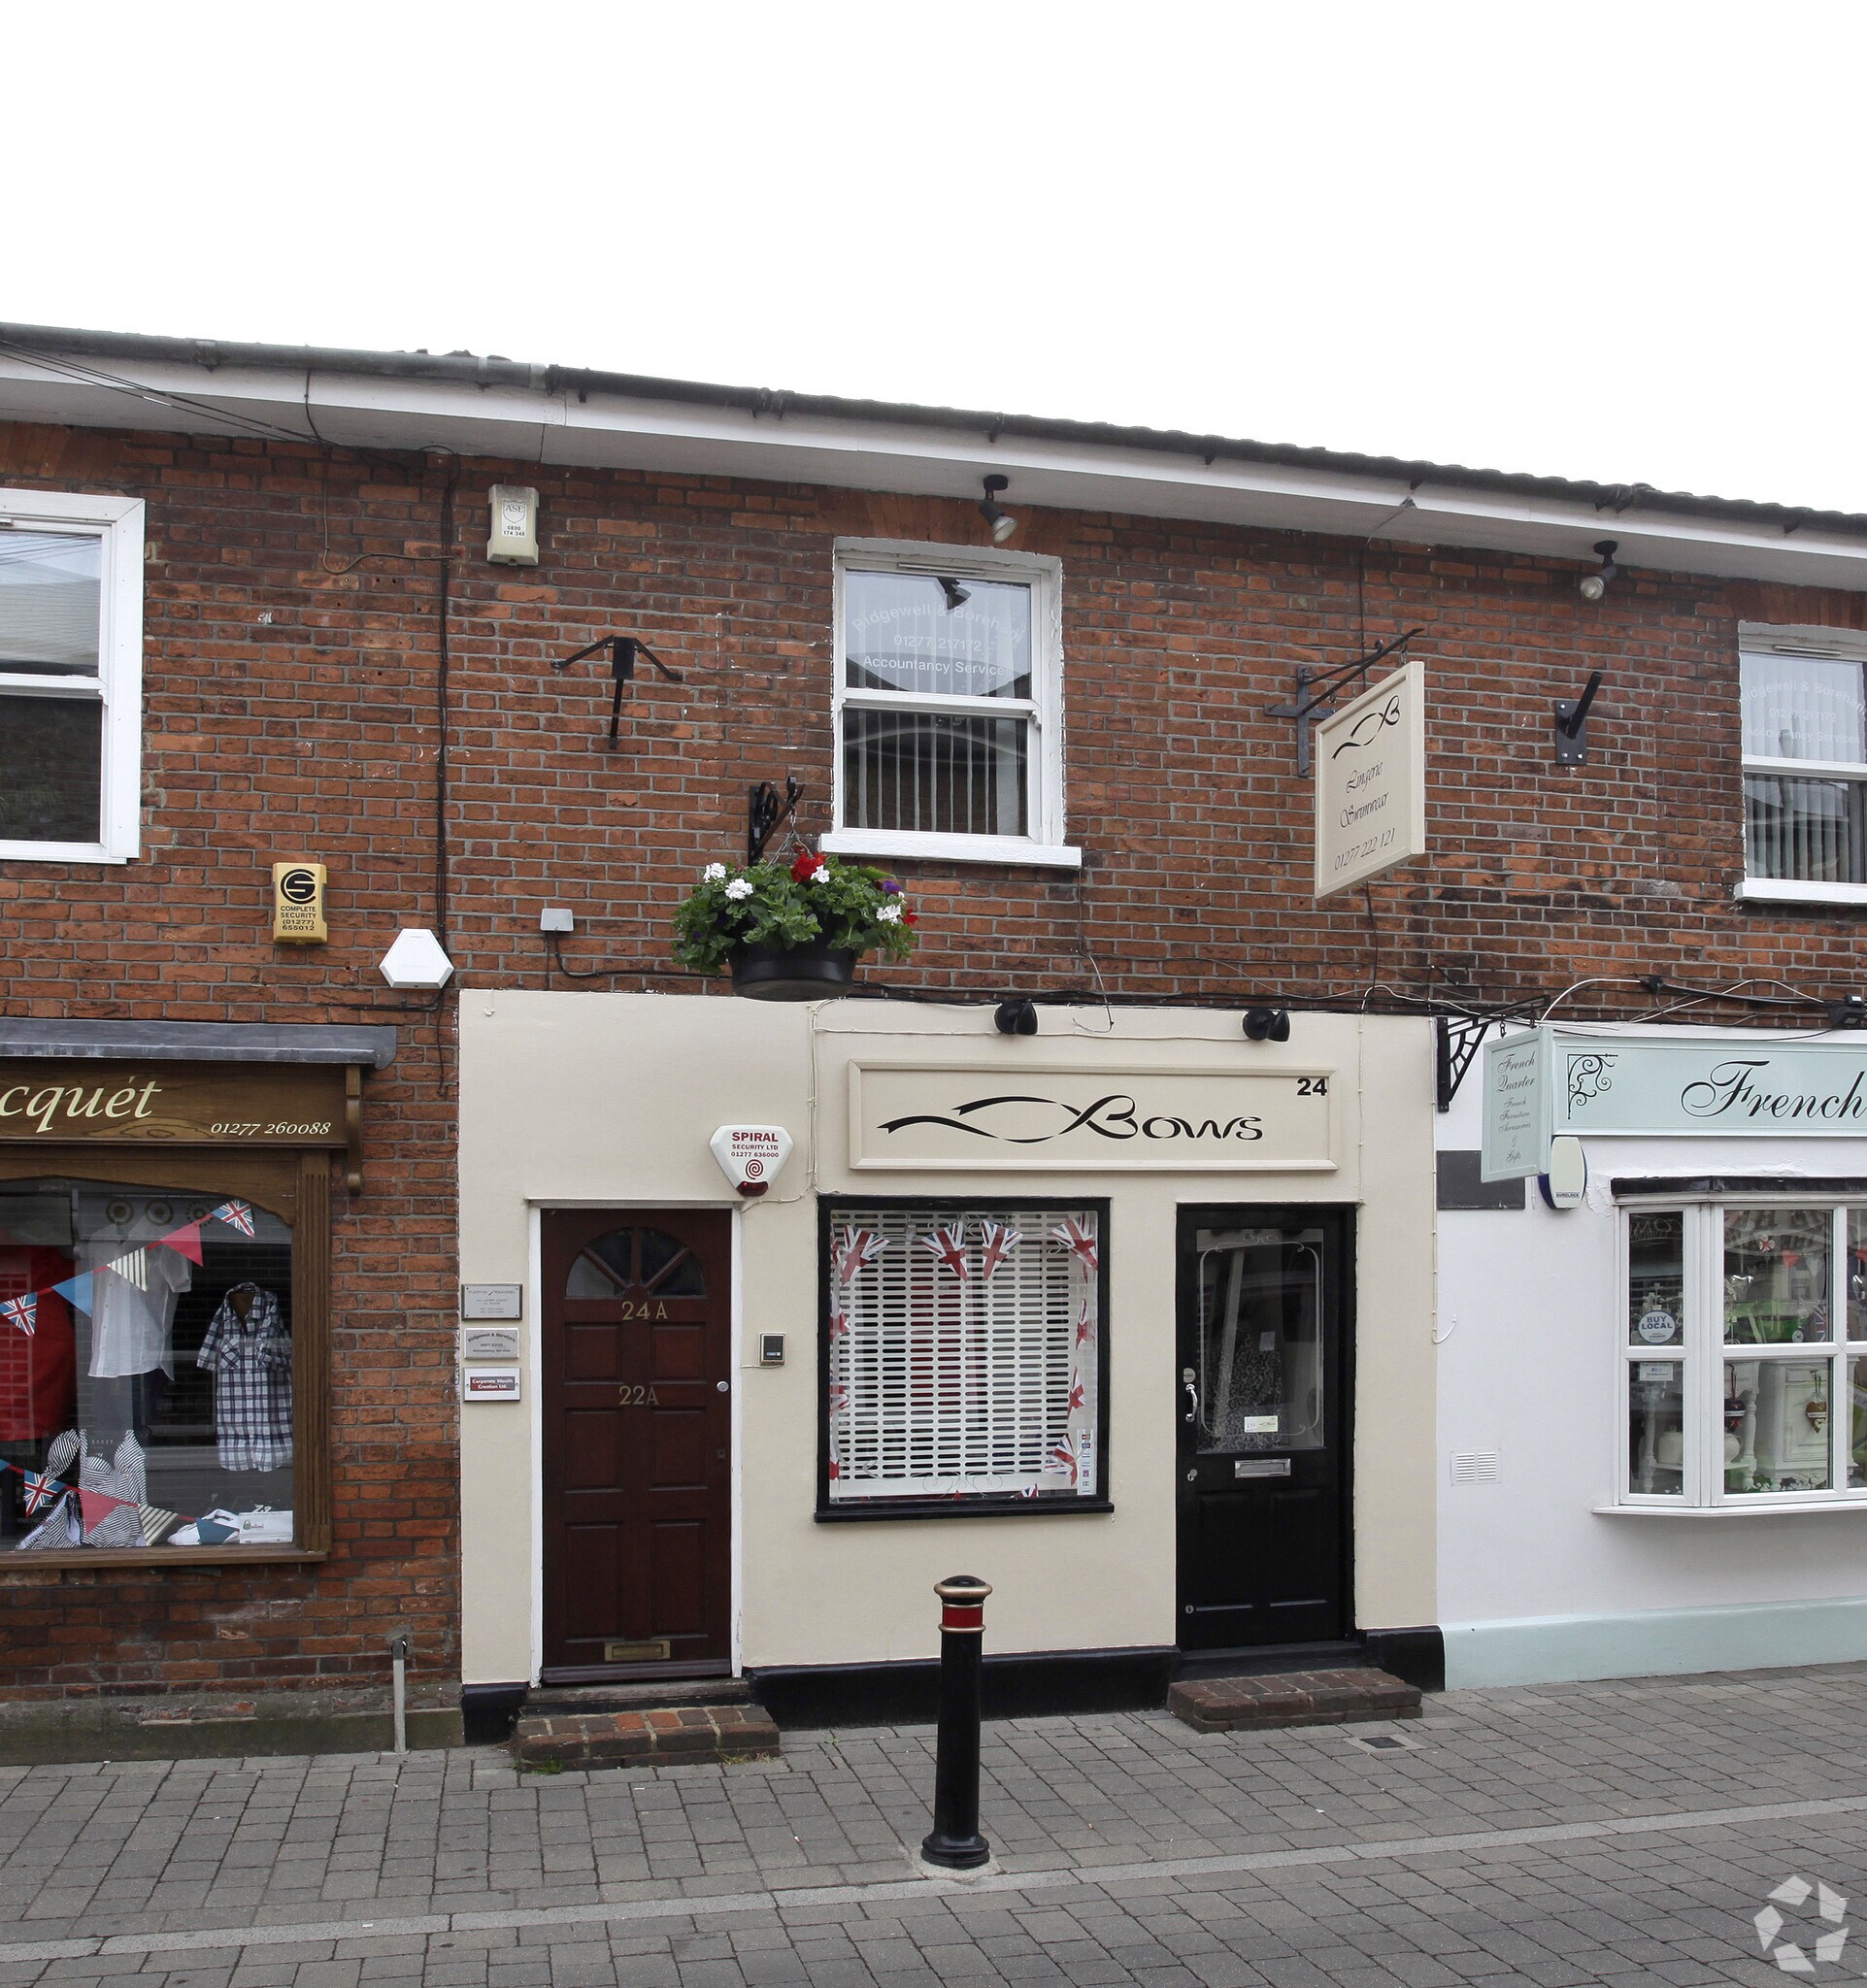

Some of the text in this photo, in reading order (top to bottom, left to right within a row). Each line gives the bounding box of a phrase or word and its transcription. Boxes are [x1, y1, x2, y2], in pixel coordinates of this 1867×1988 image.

[893, 635, 982, 652] 01277 217172
[864, 656, 1012, 677] Accountancy Services
[1346, 761, 1384, 794] Lingerie
[1340, 792, 1389, 828] Swimwear
[1335, 827, 1396, 871] 01277 222 121
[1497, 1050, 1536, 1074] French
[1296, 1077, 1327, 1096] 24
[1496, 1075, 1536, 1093] Quarter
[1681, 1060, 1867, 1119] French
[1504, 1097, 1526, 1109] French
[210, 1121, 331, 1136] 01277 260088
[732, 1132, 779, 1142] SPIRAL
[618, 1385, 660, 1406] 22A
